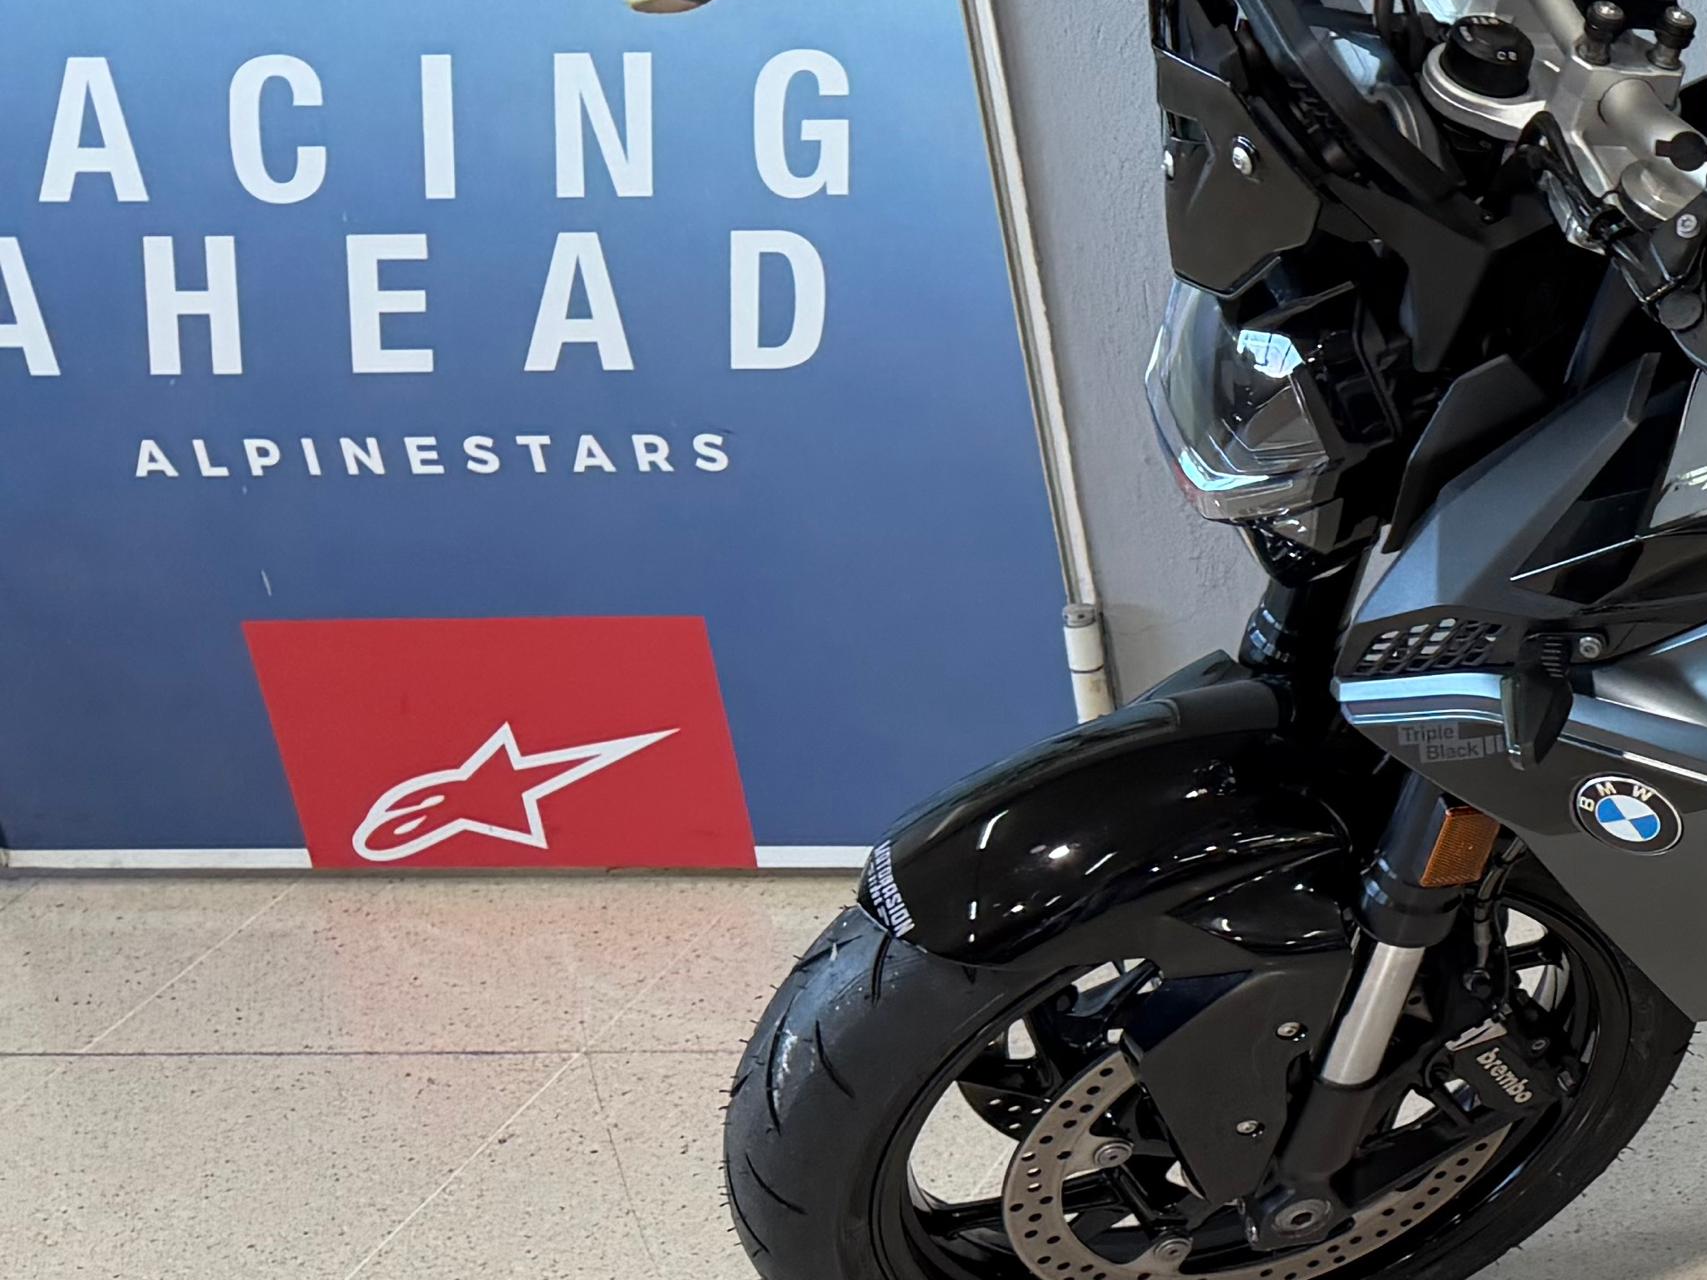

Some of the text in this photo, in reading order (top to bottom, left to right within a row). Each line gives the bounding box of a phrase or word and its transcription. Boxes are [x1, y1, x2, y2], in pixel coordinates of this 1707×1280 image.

[0, 230, 827, 376] AHEAD
[136, 433, 730, 477] ALPINESTARS
[1401, 724, 1455, 743] Triple
[1425, 741, 1480, 760] Black
[1579, 781, 1654, 812] BMW
[1476, 1047, 1533, 1104] brembo
